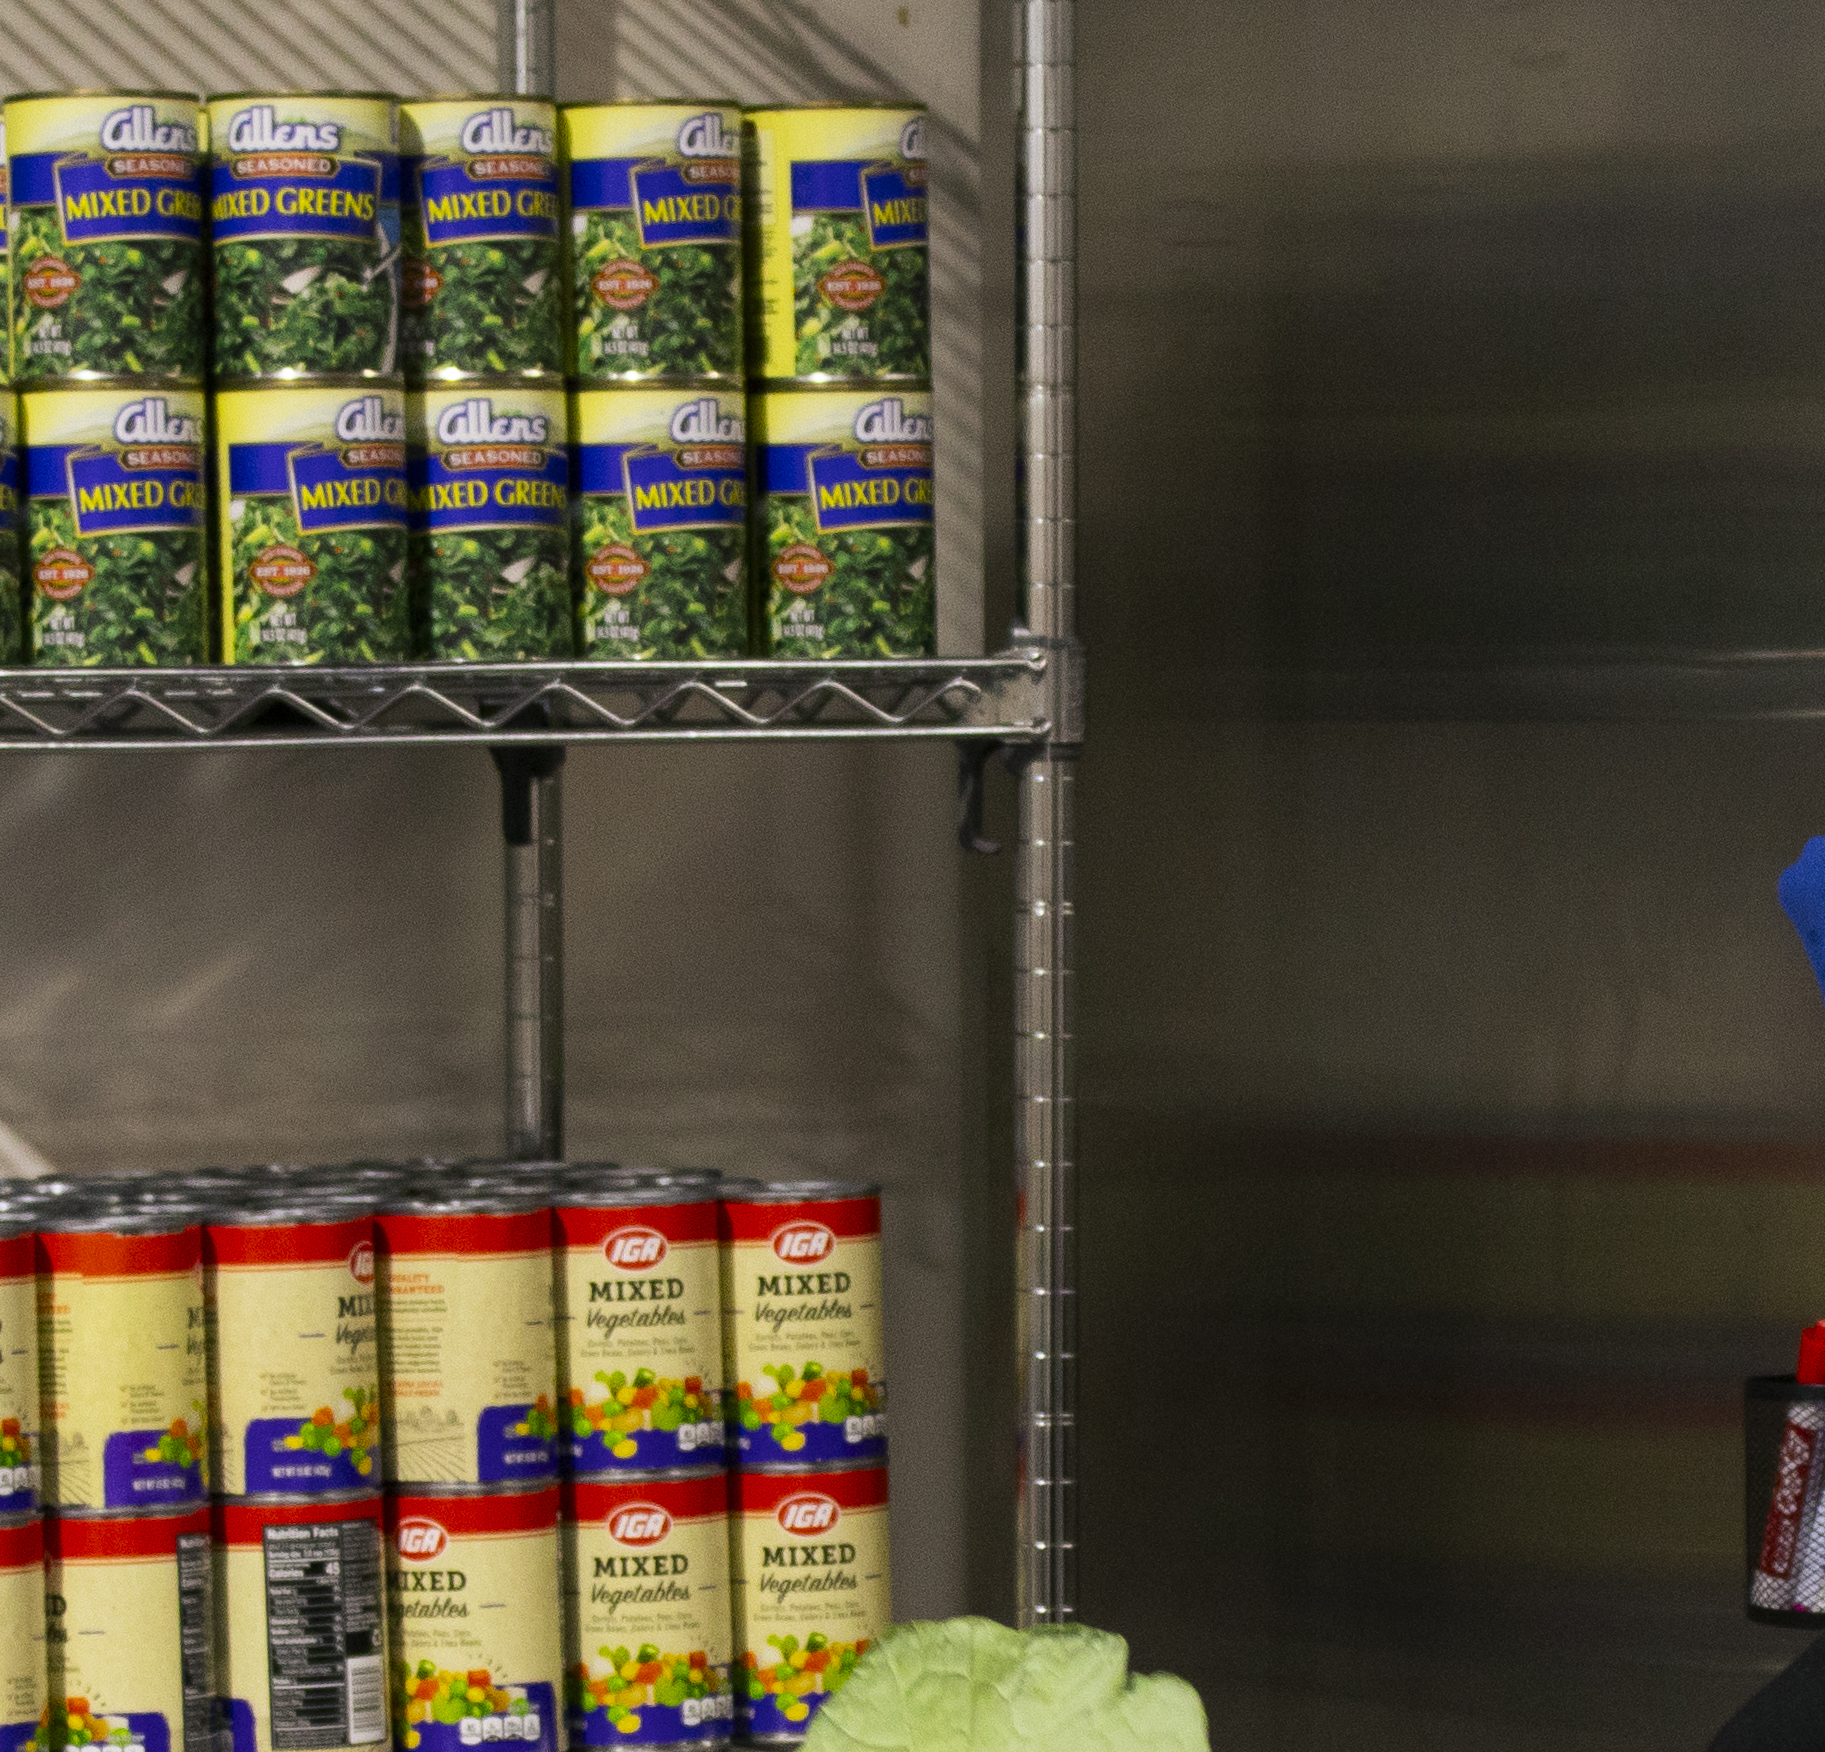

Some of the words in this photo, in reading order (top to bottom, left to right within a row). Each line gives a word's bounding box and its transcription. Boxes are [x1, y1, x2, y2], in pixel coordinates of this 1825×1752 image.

[66, 188, 151, 221] MIXED
[276, 188, 375, 221] GREENS
[428, 190, 511, 224] MIXED
[643, 193, 720, 225] MIXED
[79, 480, 164, 513] MIXED
[301, 478, 380, 511] MIXED
[635, 479, 714, 510] MIXED
[820, 479, 900, 510] MIXED
[611, 1237, 661, 1263] IGA
[779, 1232, 829, 1257] IGA
[588, 1278, 684, 1302] MIXED
[758, 1272, 851, 1296] MIXED
[587, 1305, 686, 1340] Vegetables
[755, 1299, 852, 1333] Vegetables
[615, 1513, 664, 1538] IGA
[784, 1502, 832, 1527] IGA
[593, 1554, 689, 1577] MIXED
[762, 1544, 857, 1567] MIXED
[591, 1581, 691, 1616] Vegetables
[760, 1572, 858, 1606] Vegetables
